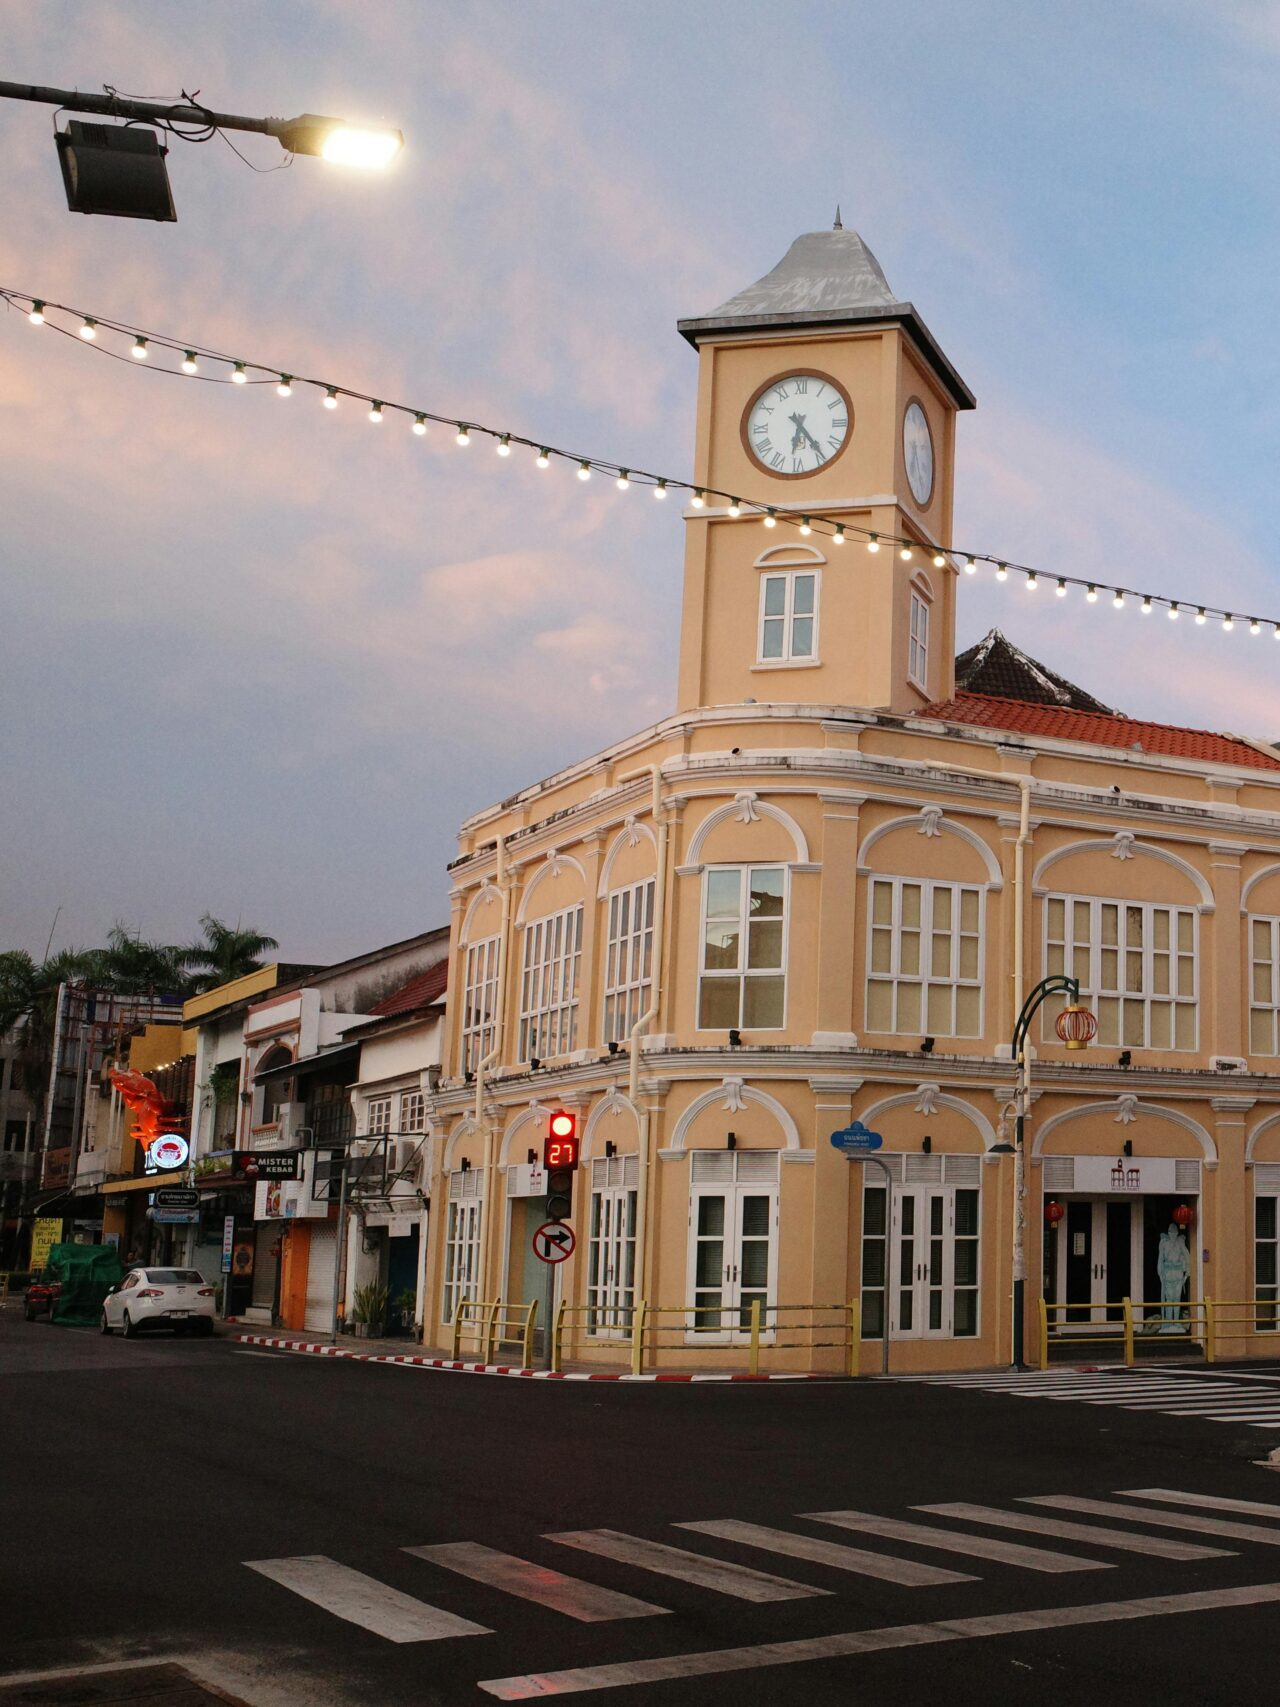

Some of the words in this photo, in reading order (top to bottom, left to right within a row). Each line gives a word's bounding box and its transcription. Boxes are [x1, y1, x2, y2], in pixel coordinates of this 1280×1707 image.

[773, 384, 790, 402] XI
[794, 379, 808, 394] XII
[759, 401, 775, 415] X
[827, 398, 842, 410] II
[753, 422, 768, 434] IX
[831, 418, 847, 428] III
[755, 437, 774, 458] VIII
[769, 452, 786, 470] VII
[792, 457, 805, 472] VI
[550, 1145, 573, 1163] 27
